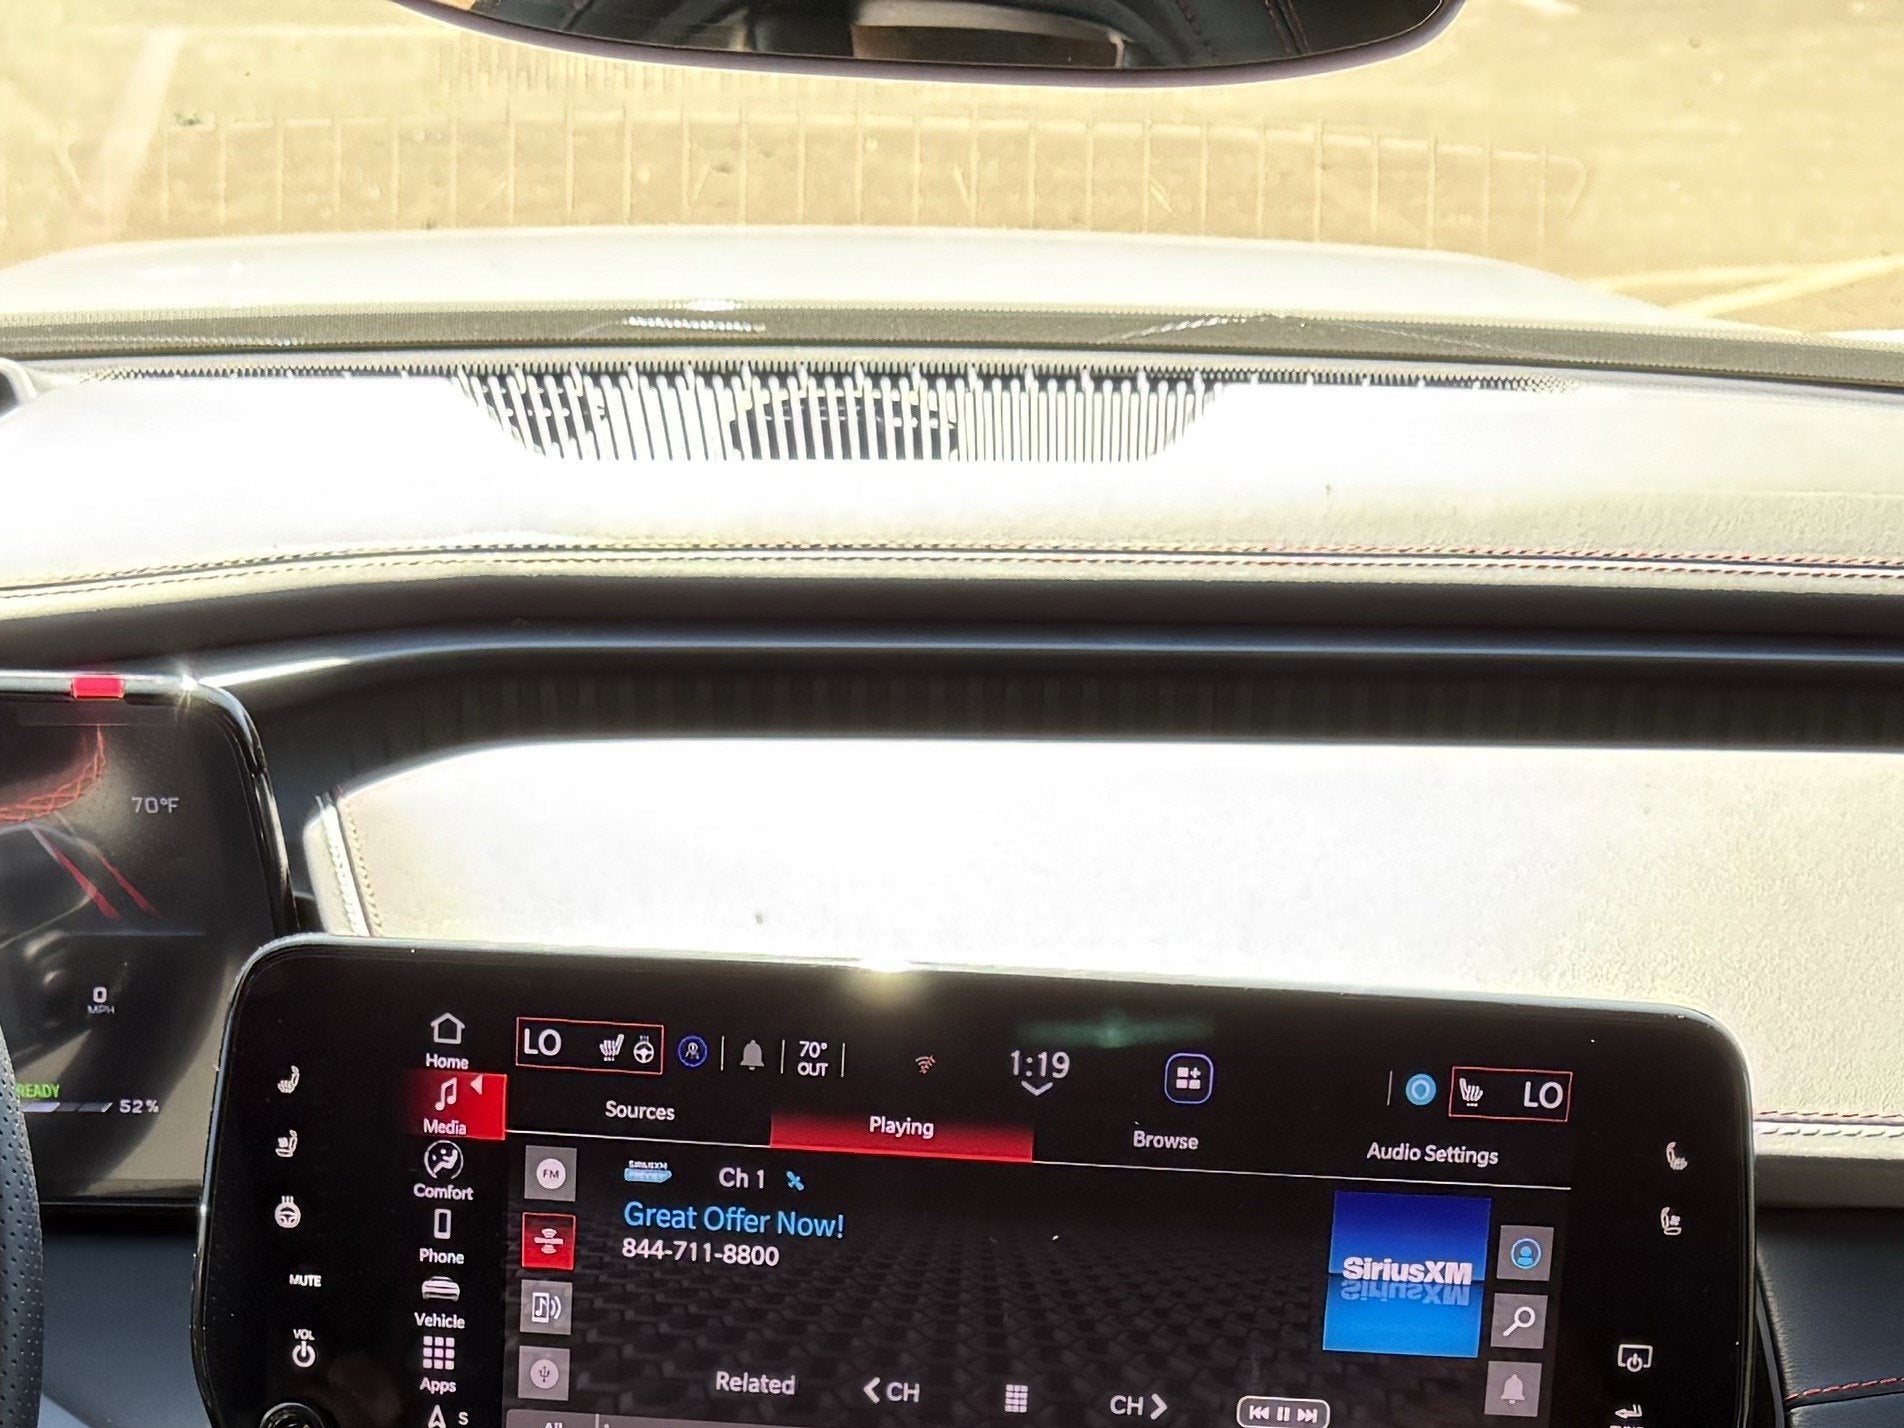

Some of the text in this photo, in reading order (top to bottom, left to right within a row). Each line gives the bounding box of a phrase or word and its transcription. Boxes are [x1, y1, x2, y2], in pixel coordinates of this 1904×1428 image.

[92, 986, 108, 1003] 0
[523, 1028, 562, 1057] LO
[798, 1038, 829, 1060] 70°
[425, 1052, 469, 1071] Home
[797, 1061, 829, 1078] OUT
[1010, 1049, 1070, 1080] 1:19
[16, 1084, 60, 1098] READY
[1523, 1081, 1564, 1109] LO
[605, 1100, 675, 1122] Sources
[423, 1118, 467, 1136] Media
[869, 1115, 935, 1140] Playing
[1132, 1130, 1199, 1151] Browse
[1367, 1141, 1499, 1169] Audio Settings
[542, 1168, 560, 1180] FM
[718, 1167, 765, 1188] Ch 1
[413, 1183, 474, 1201] Comfort
[623, 1201, 845, 1239] Great Offer Now!
[419, 1248, 465, 1265] Phone
[622, 1237, 780, 1267] 844-711-8800
[289, 1273, 322, 1287] MUTE
[1342, 1255, 1473, 1286] SiriusXM
[414, 1312, 466, 1330] Vehicle
[292, 1329, 315, 1341] VOL
[420, 1376, 457, 1396] Apps
[715, 1371, 797, 1396] Related
[886, 1380, 921, 1403] CH
[1109, 1394, 1145, 1418] CH
[458, 1411, 469, 1427] S
